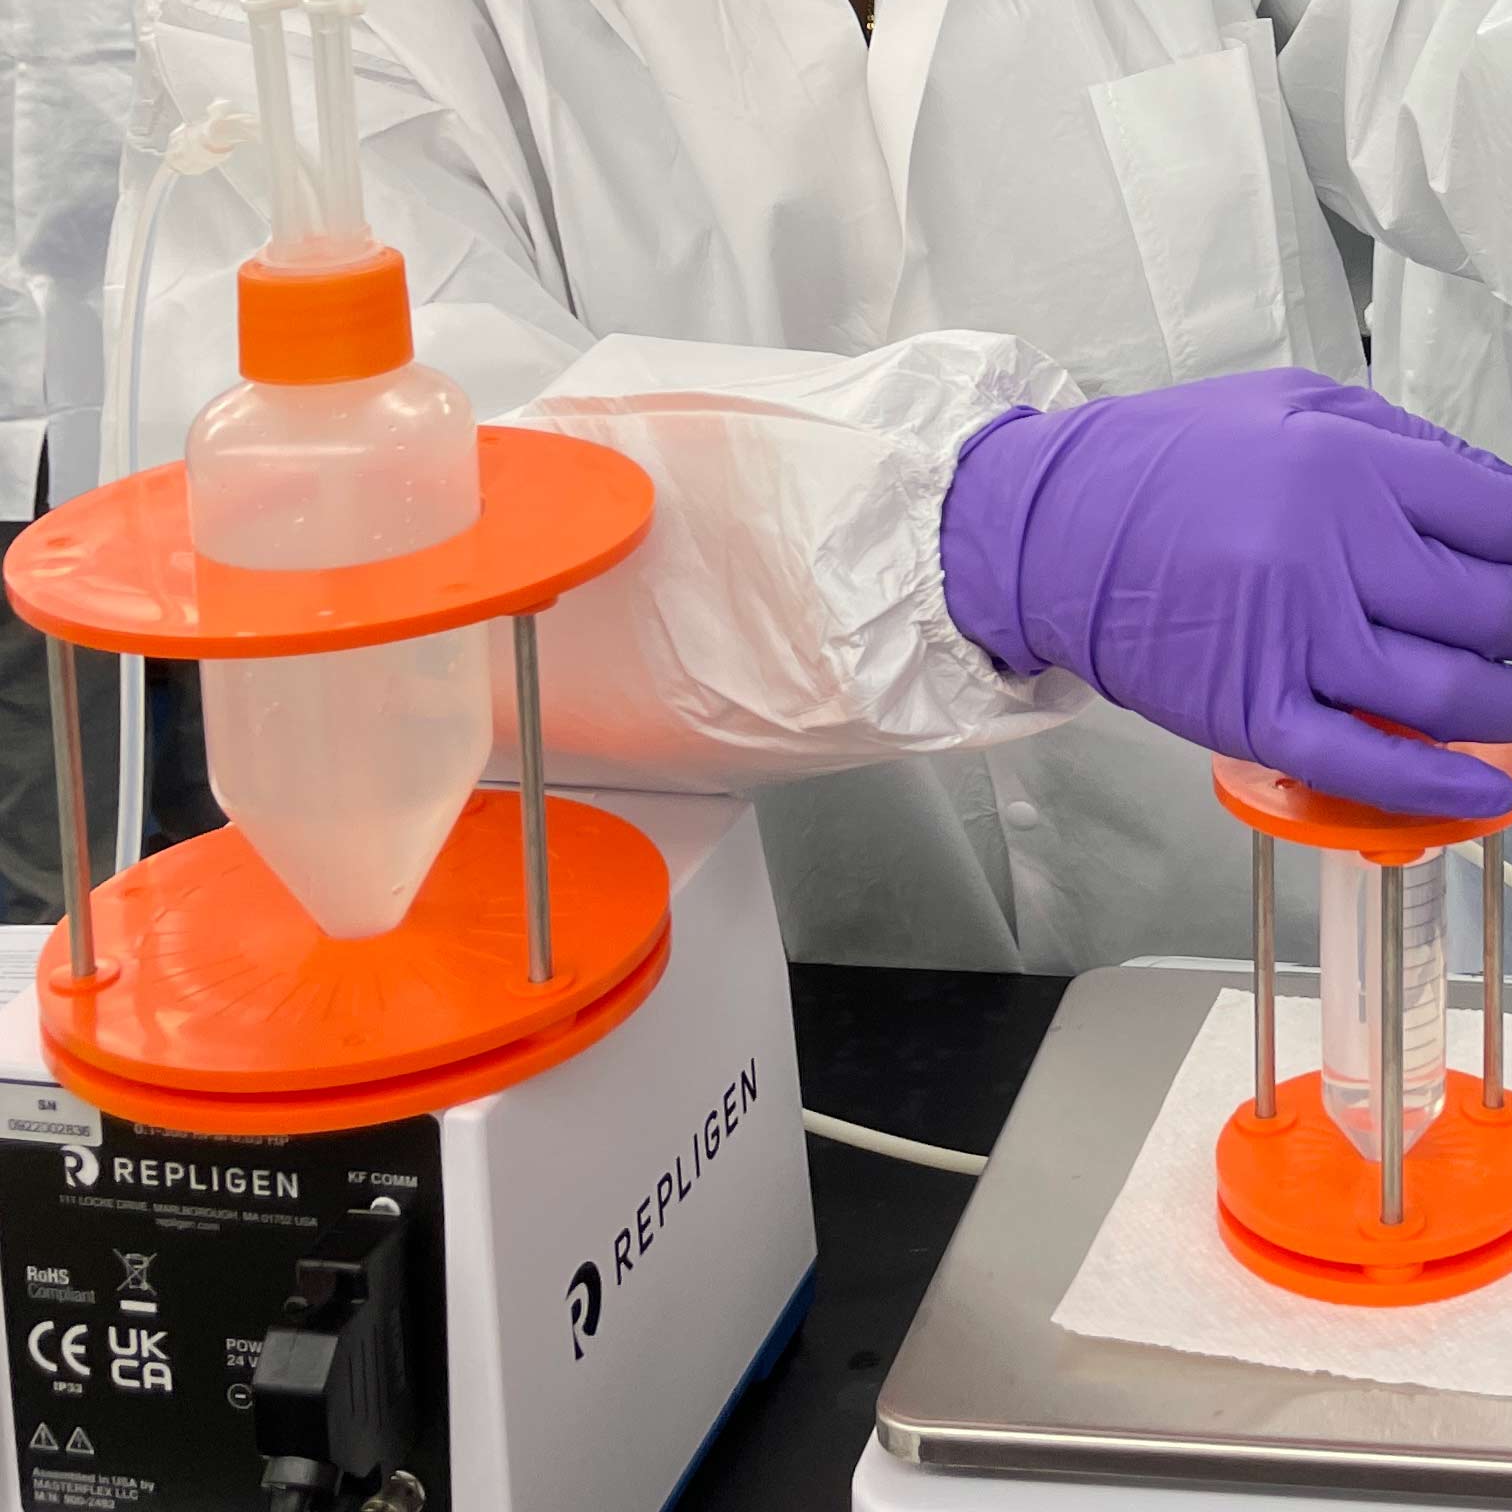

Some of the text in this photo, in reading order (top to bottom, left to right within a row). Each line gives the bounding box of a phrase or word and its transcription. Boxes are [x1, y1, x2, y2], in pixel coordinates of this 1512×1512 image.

[112, 1156, 300, 1199] REPLIGEN
[371, 1172, 419, 1188] COMM
[614, 1057, 758, 1286] REPLIGEN
[26, 1265, 70, 1285] RoHS
[27, 1283, 97, 1304] Compliant
[108, 1326, 170, 1360] UK
[225, 1338, 263, 1354] POW
[226, 1353, 245, 1367] 24
[111, 1358, 173, 1392] CA
